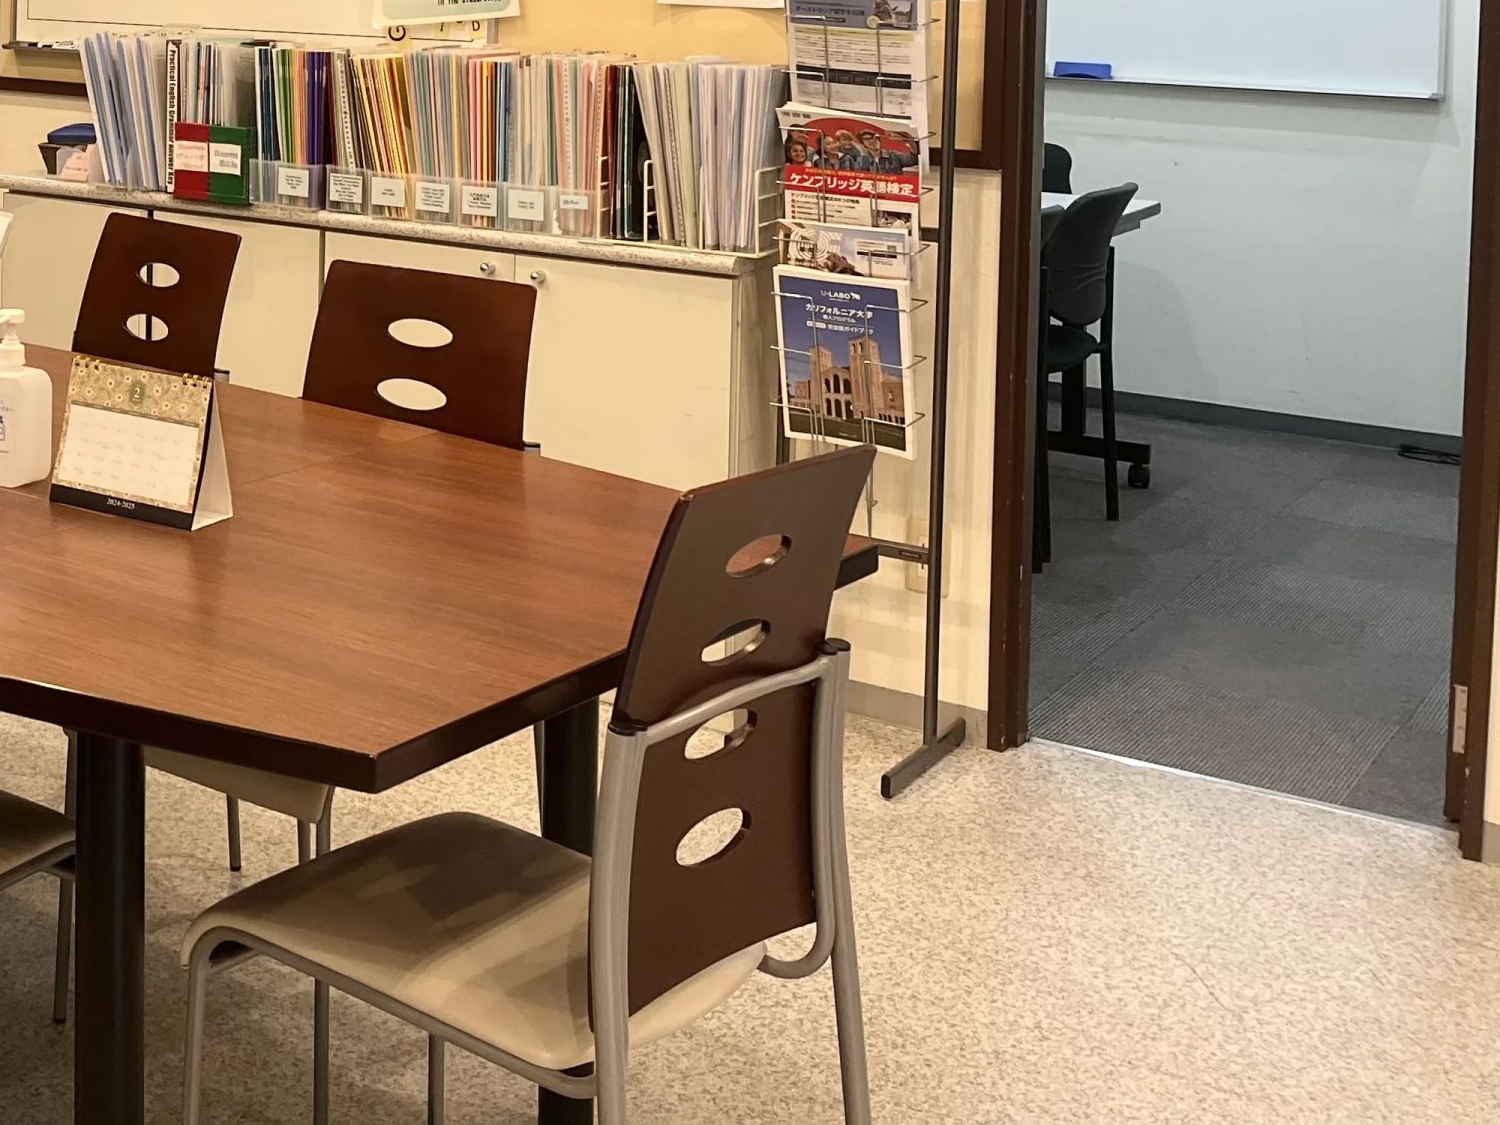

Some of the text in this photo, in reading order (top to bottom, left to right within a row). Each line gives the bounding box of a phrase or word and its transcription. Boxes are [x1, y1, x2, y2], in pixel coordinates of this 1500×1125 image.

[166, 49, 177, 185] Practical English Grammar Answer Key
[790, 173, 915, 196] ケンブリッジ英語検定
[805, 303, 873, 319] カリフォルニア大学
[134, 387, 140, 399] 2
[106, 497, 136, 510] 2024-2025
